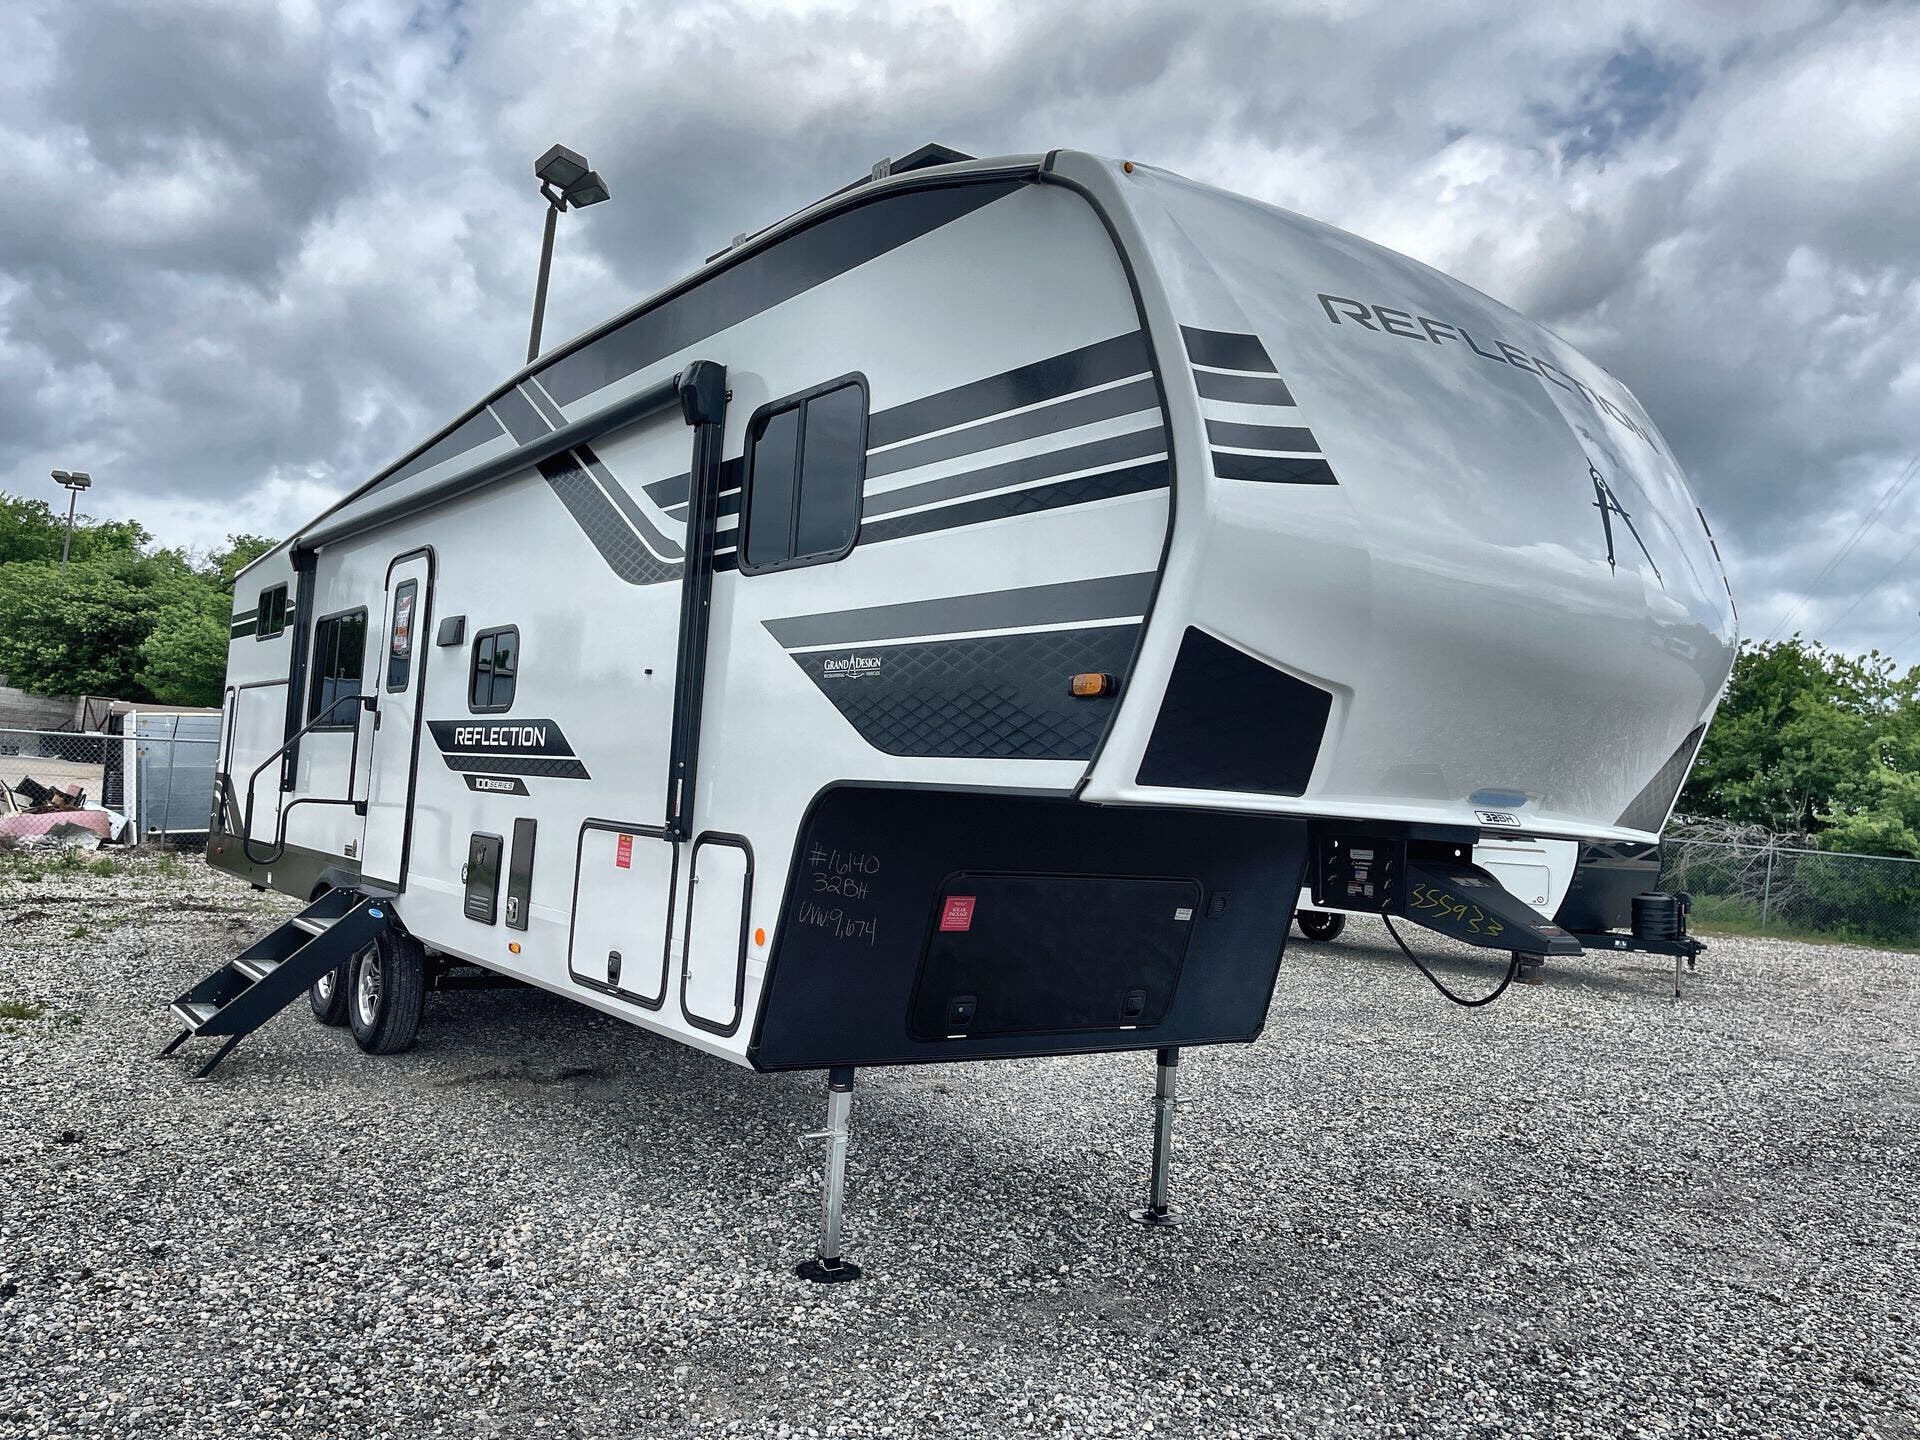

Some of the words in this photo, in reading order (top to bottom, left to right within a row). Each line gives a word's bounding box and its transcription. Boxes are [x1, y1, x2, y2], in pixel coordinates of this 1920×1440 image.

[1317, 293, 1661, 455] REFLECTION
[824, 659, 849, 670] GRAND
[856, 657, 882, 668] DESIGN
[454, 726, 546, 747] REFLECTION
[475, 778, 489, 790] 100
[489, 780, 514, 790] SERIES
[1482, 812, 1515, 824] 32BH
[812, 872, 870, 900] 32BH
[1410, 883, 1504, 937] 355933
